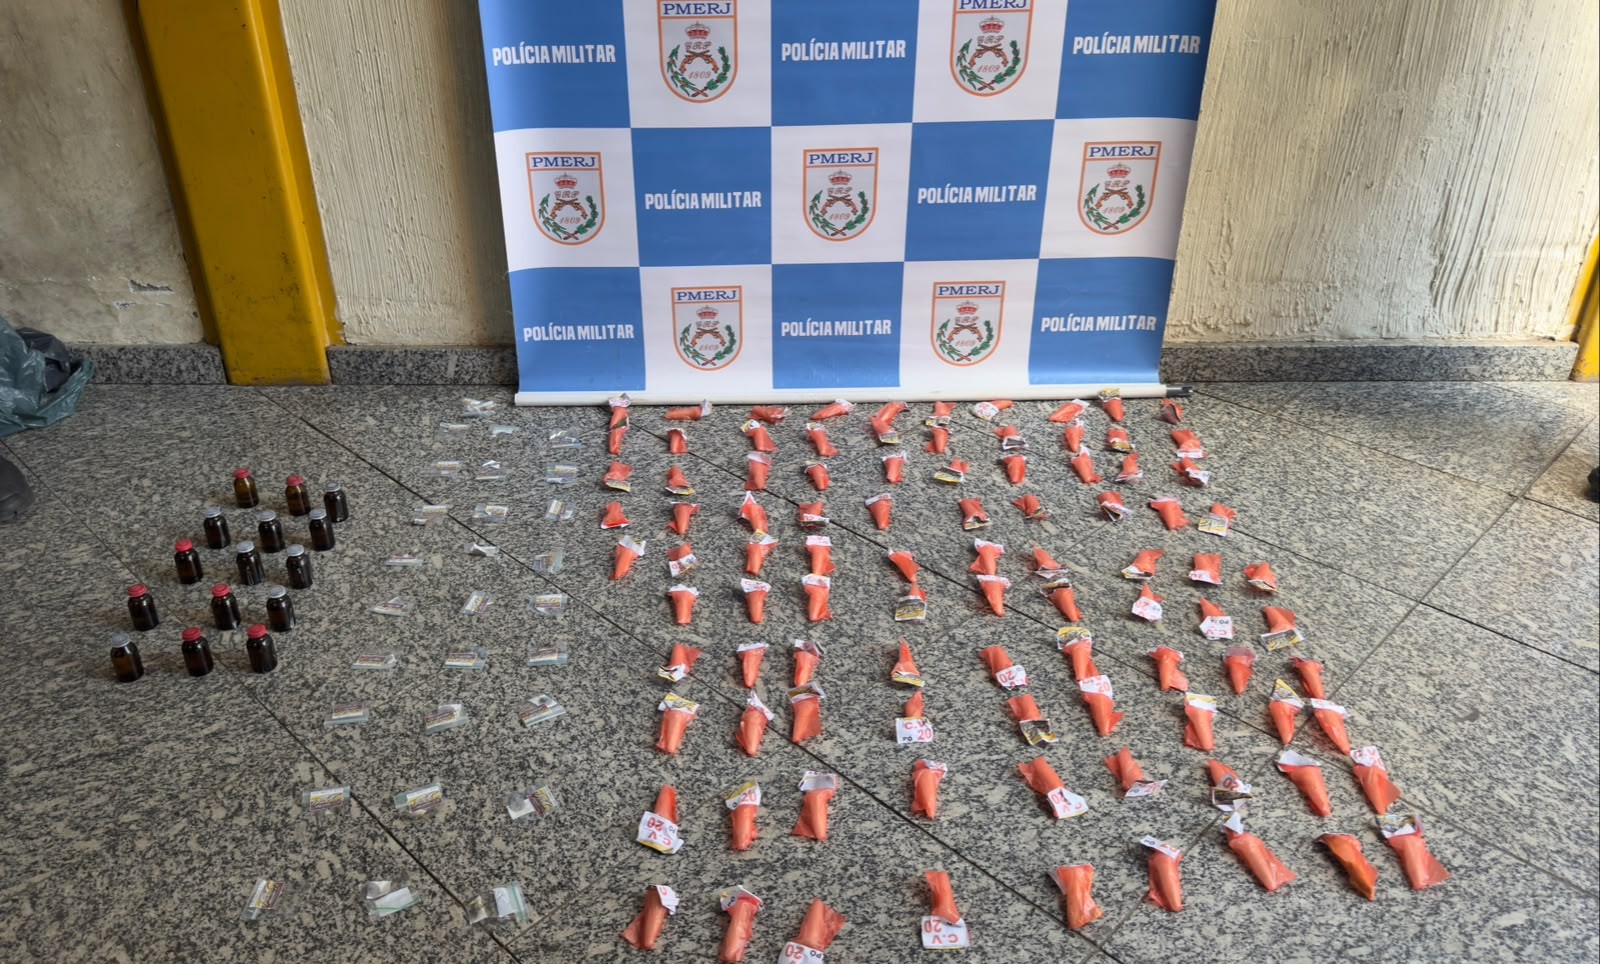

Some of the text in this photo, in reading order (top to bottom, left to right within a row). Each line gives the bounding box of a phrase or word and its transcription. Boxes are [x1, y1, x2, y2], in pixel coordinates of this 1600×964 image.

[663, 3, 731, 15] PMERJ
[959, 0, 1027, 9] PMERJ
[1072, 31, 1200, 55] POLÍCIA MILITAR
[491, 41, 616, 66] POLÍCIA MILITAR
[781, 38, 907, 62] POLÍCIA MILITAR
[688, 71, 711, 79] 1809
[977, 65, 1001, 73] 1809
[1089, 146, 1156, 157] PMERJ
[531, 157, 596, 168] PMERJ
[808, 153, 873, 165] PMERJ
[644, 189, 762, 210] POLÍCIA MILITAR
[917, 183, 1037, 204] POLÍCIA MILITAR
[676, 290, 737, 301] PMERJ
[938, 285, 1000, 295] PMERJ
[781, 317, 892, 337] POLÍCIA MILITAR
[1040, 313, 1156, 332] POLÍCIA MILITAR
[523, 322, 634, 342] POLÍCIA MILITAR
[917, 728, 932, 740] 20
[924, 920, 942, 934] 20
[785, 944, 804, 960] 20
